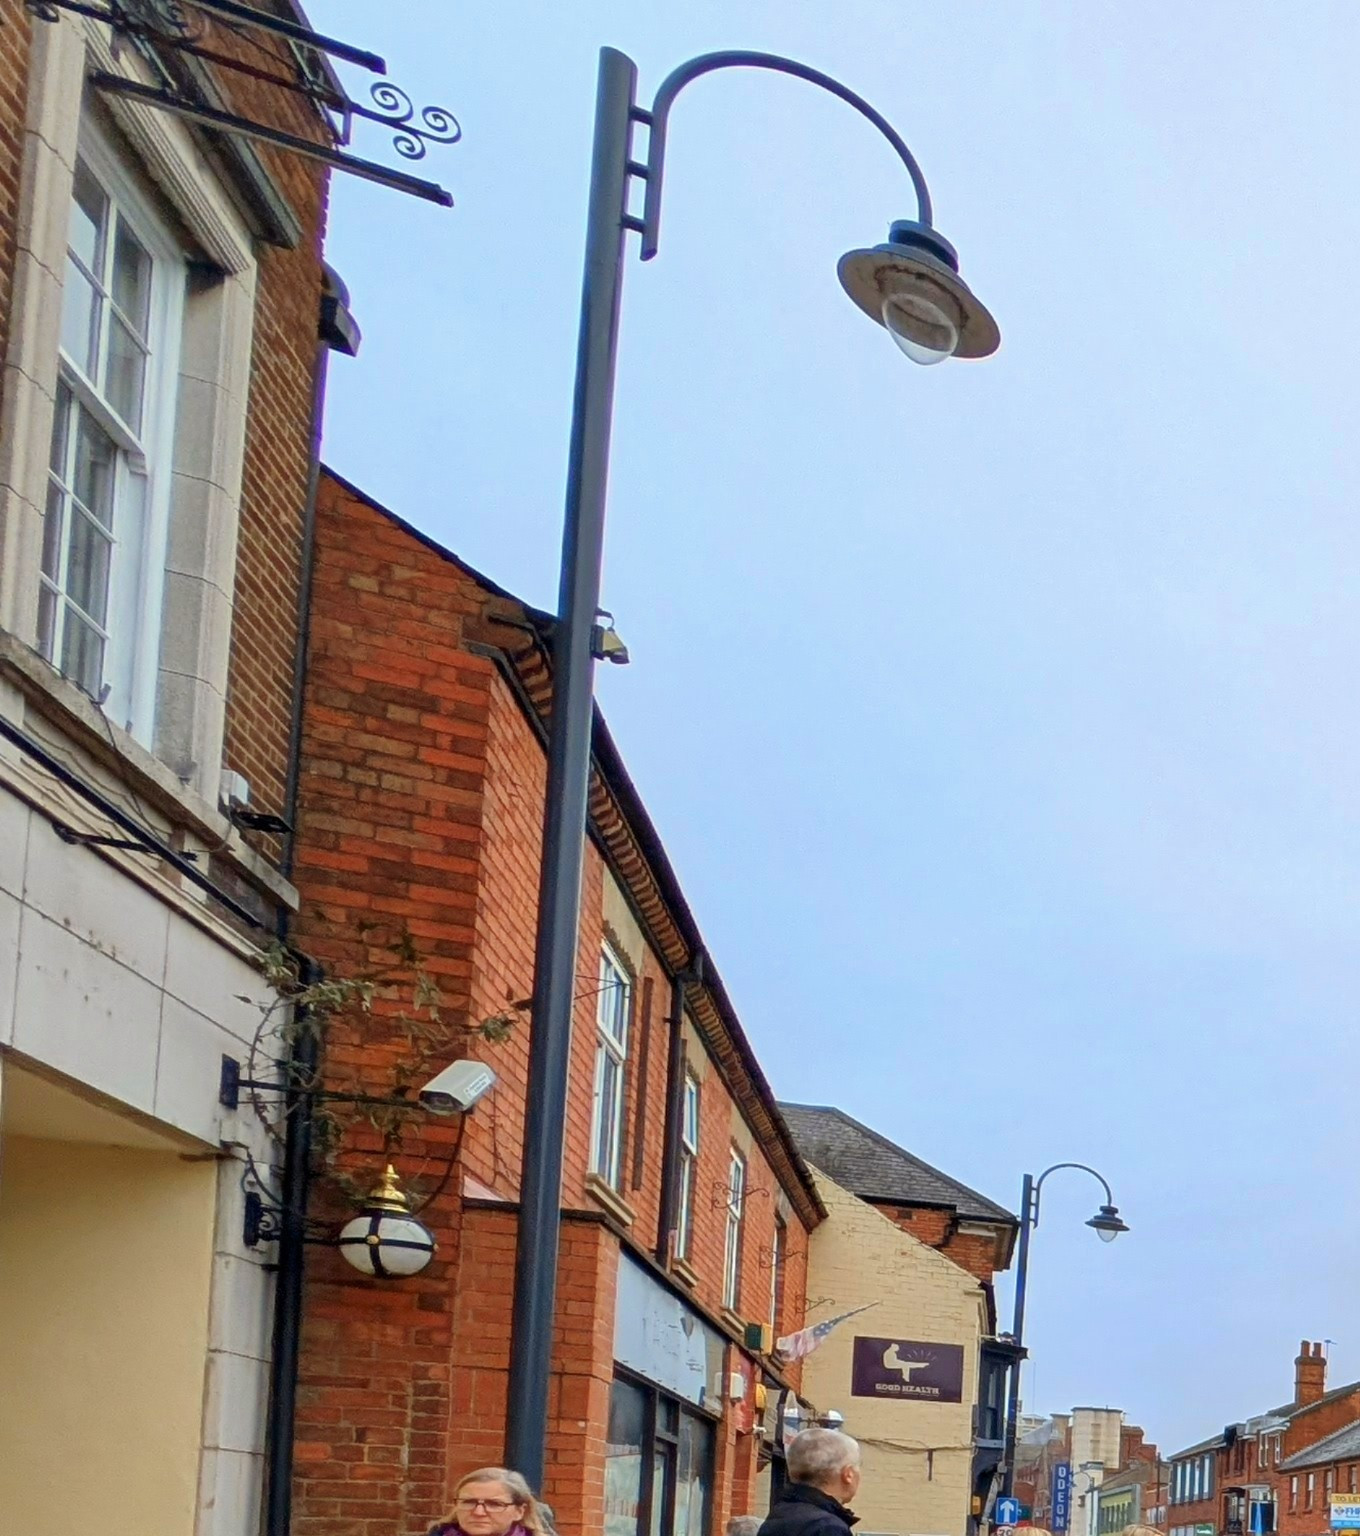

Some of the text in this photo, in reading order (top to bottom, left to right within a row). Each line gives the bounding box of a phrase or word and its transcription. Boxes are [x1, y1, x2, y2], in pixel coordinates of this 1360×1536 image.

[875, 1383, 901, 1391] GOOD
[902, 1385, 940, 1394] HEALTH
[1055, 1466, 1067, 1528] ODEON
